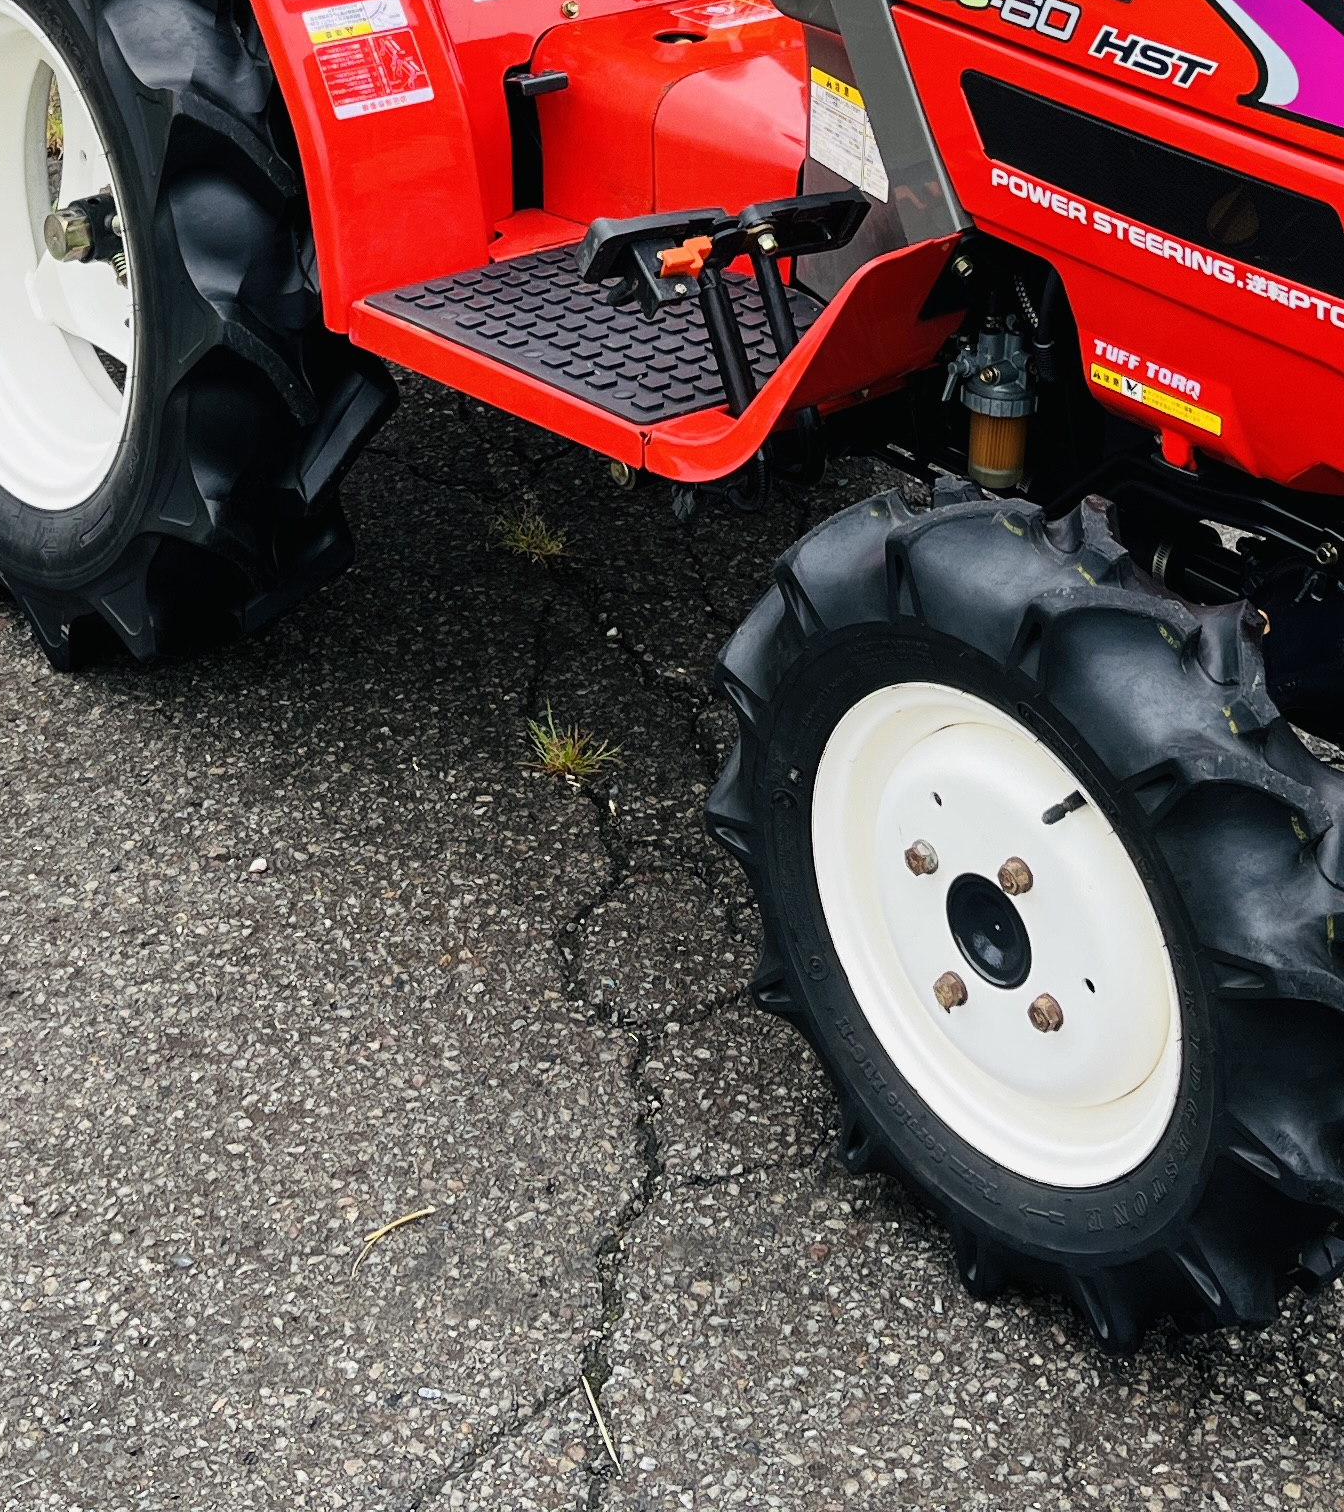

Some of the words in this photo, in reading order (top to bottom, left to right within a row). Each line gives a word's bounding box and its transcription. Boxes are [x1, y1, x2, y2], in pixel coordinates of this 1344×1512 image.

[1088, 24, 1219, 89] HST
[991, 167, 1088, 225] POWER
[1093, 338, 1142, 371] TUFF
[1145, 360, 1202, 401] TORQ
